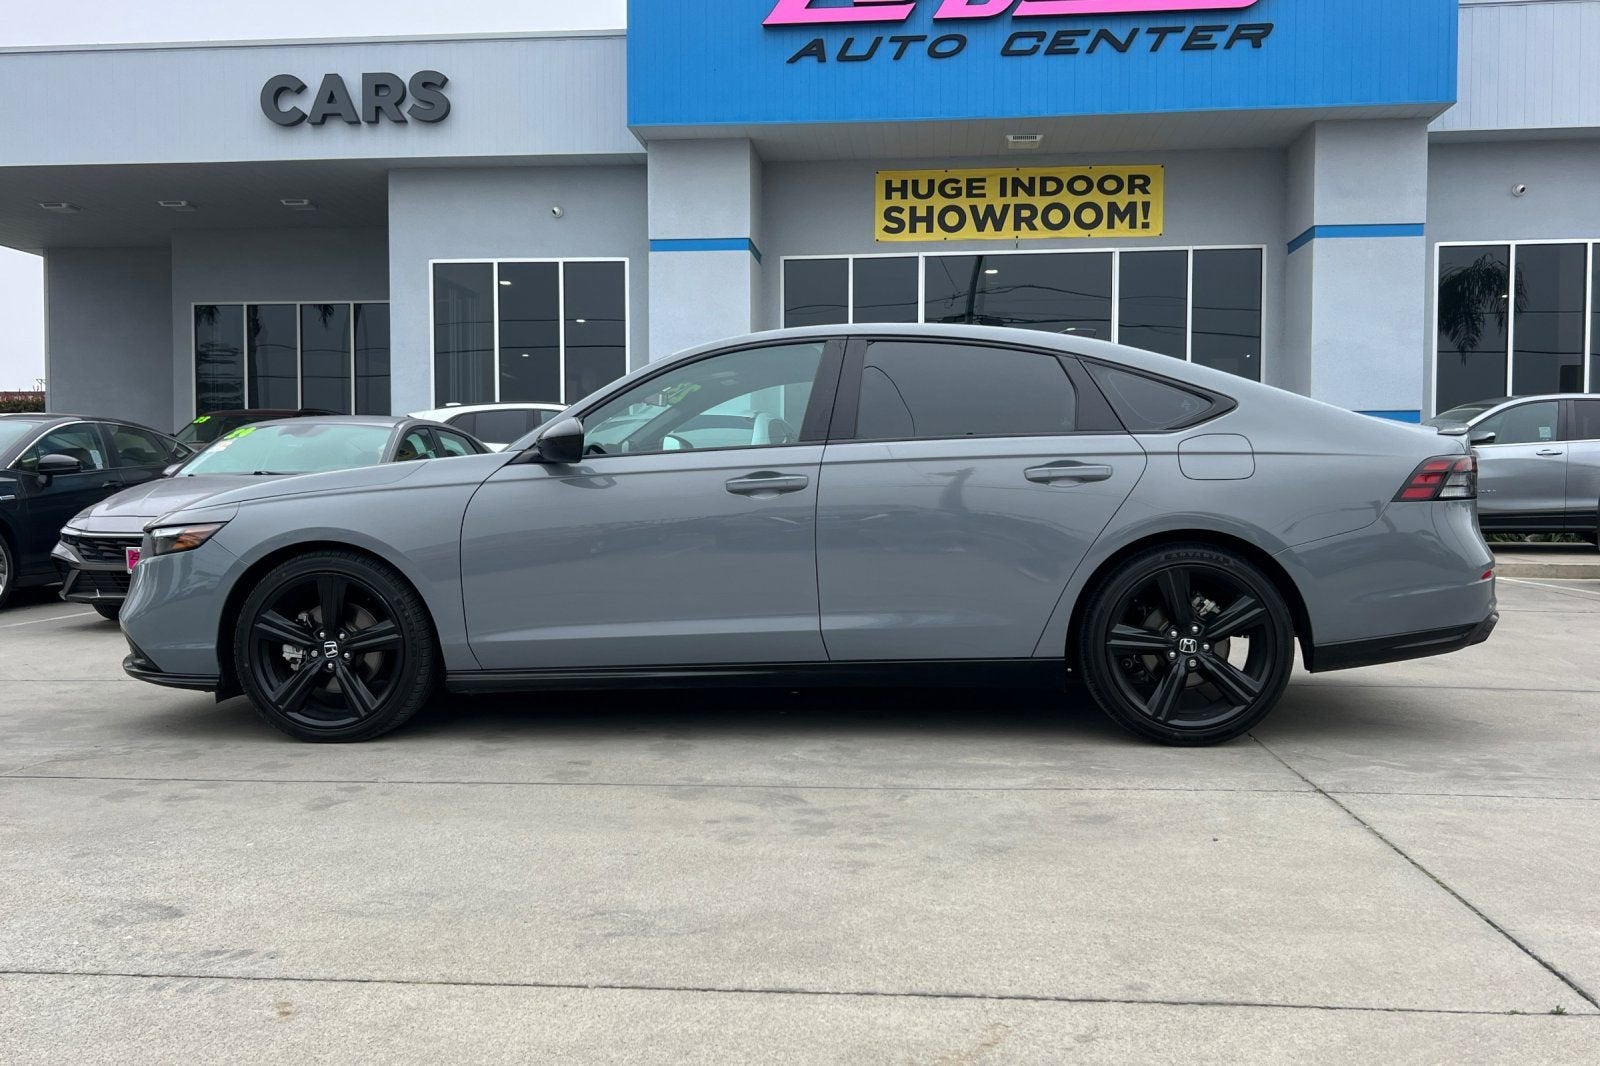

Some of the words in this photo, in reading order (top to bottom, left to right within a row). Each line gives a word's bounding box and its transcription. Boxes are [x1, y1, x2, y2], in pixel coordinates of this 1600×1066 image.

[786, 34, 967, 63] AUTO
[1001, 23, 1274, 56] CENTER
[260, 70, 451, 127] CARS
[884, 177, 987, 200] HUGE
[1000, 174, 1151, 198] INDOOR
[882, 201, 1151, 234] SHOWROOM!
